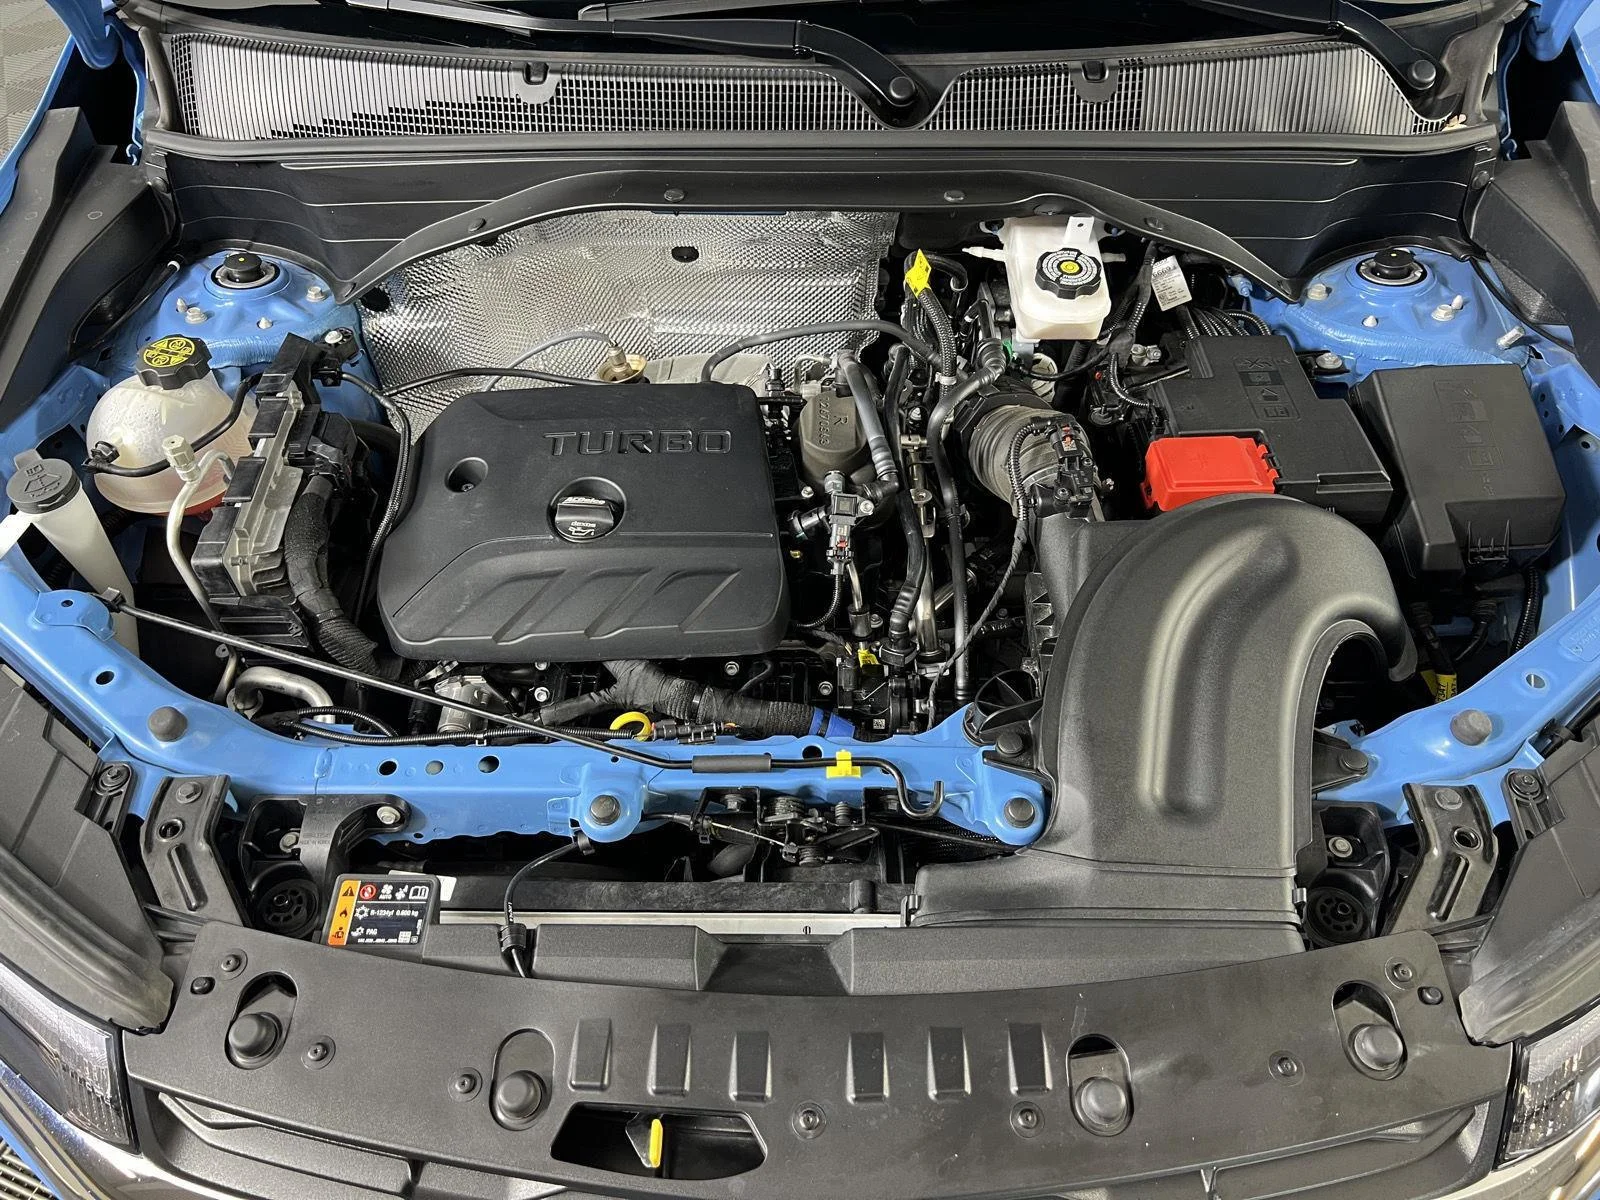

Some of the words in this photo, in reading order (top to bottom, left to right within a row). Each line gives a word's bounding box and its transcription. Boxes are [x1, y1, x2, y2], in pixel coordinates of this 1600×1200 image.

[833, 415, 848, 426] R
[543, 429, 732, 456] TURBO
[571, 520, 596, 528] dexos
[411, 909, 419, 917] kg
[365, 928, 378, 936] PAG
